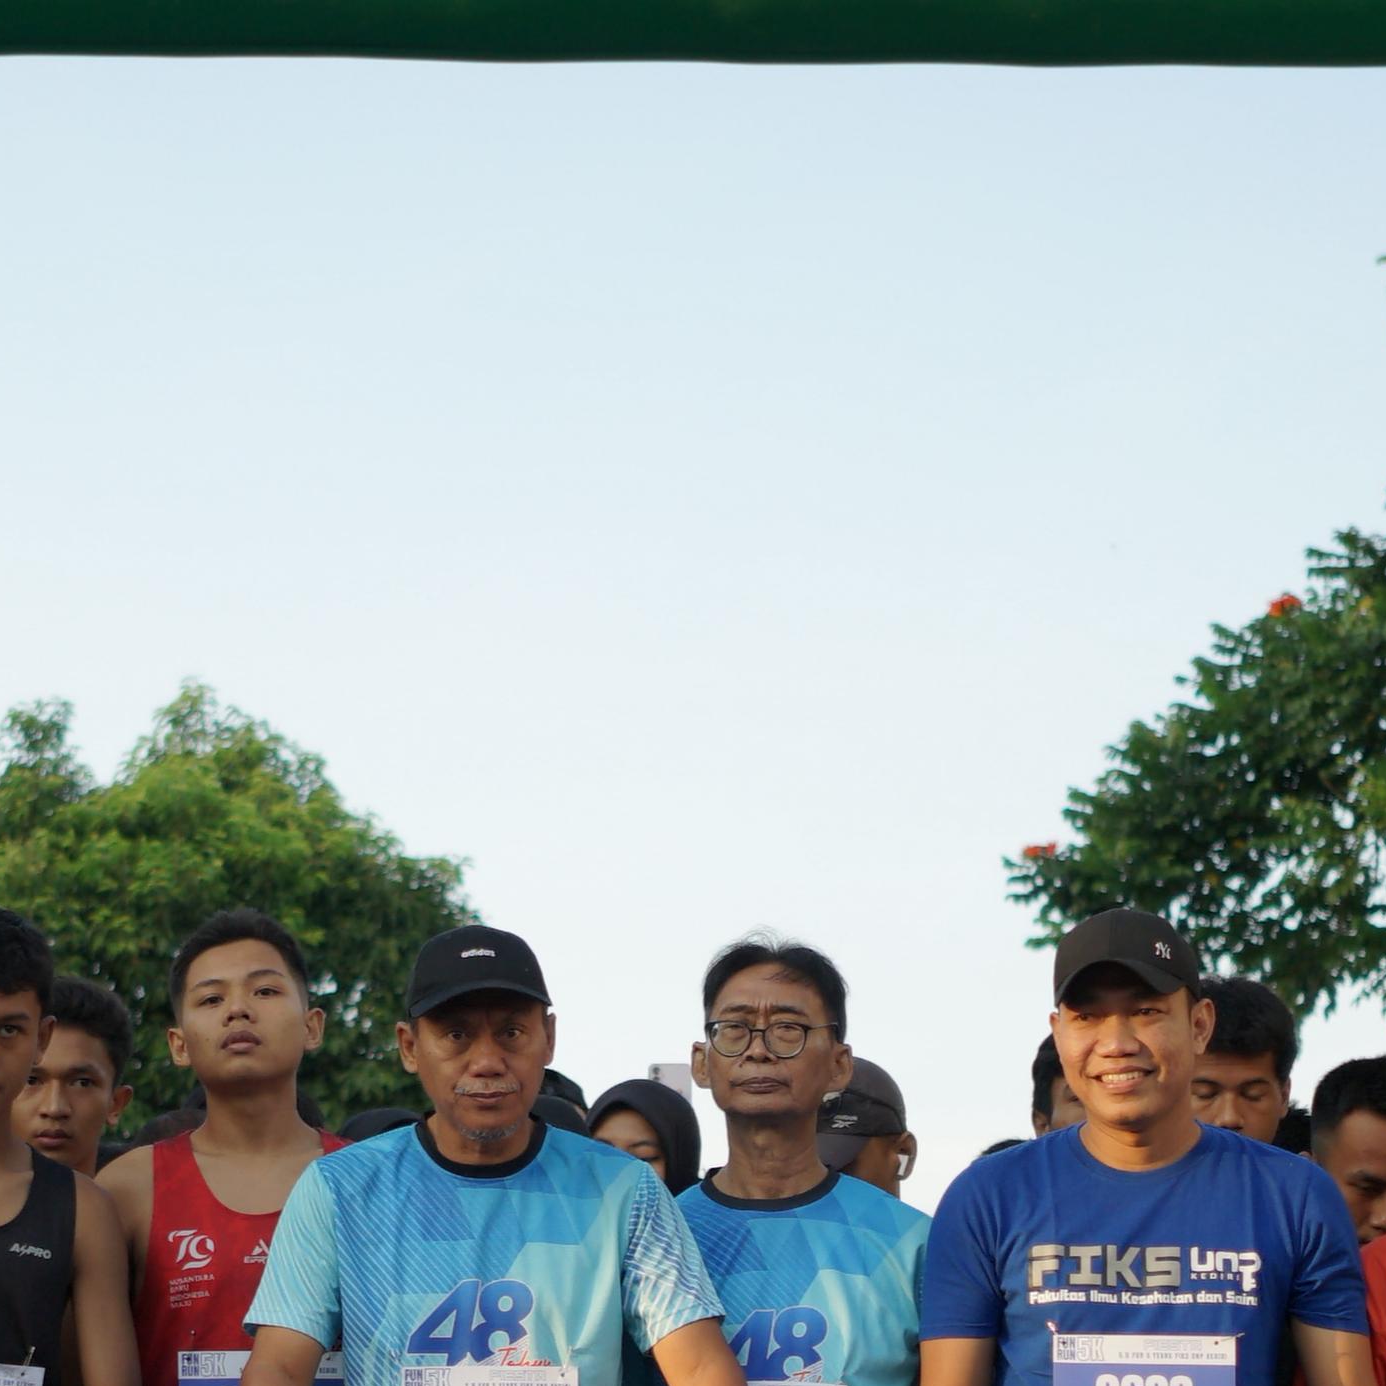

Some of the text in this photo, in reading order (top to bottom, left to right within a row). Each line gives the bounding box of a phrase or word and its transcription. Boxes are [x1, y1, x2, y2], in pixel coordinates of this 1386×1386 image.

[461, 948, 496, 958] adidas
[1029, 1244, 1182, 1289] FIKS
[1029, 1289, 1086, 1305] Fakultas
[1090, 1290, 1117, 1303] Ilmu
[1121, 1291, 1194, 1305] Kesehatan
[1197, 1290, 1223, 1303] dan
[406, 1279, 535, 1367] 48
[728, 1305, 828, 1382] 48
[404, 1368, 423, 1381] FUN
